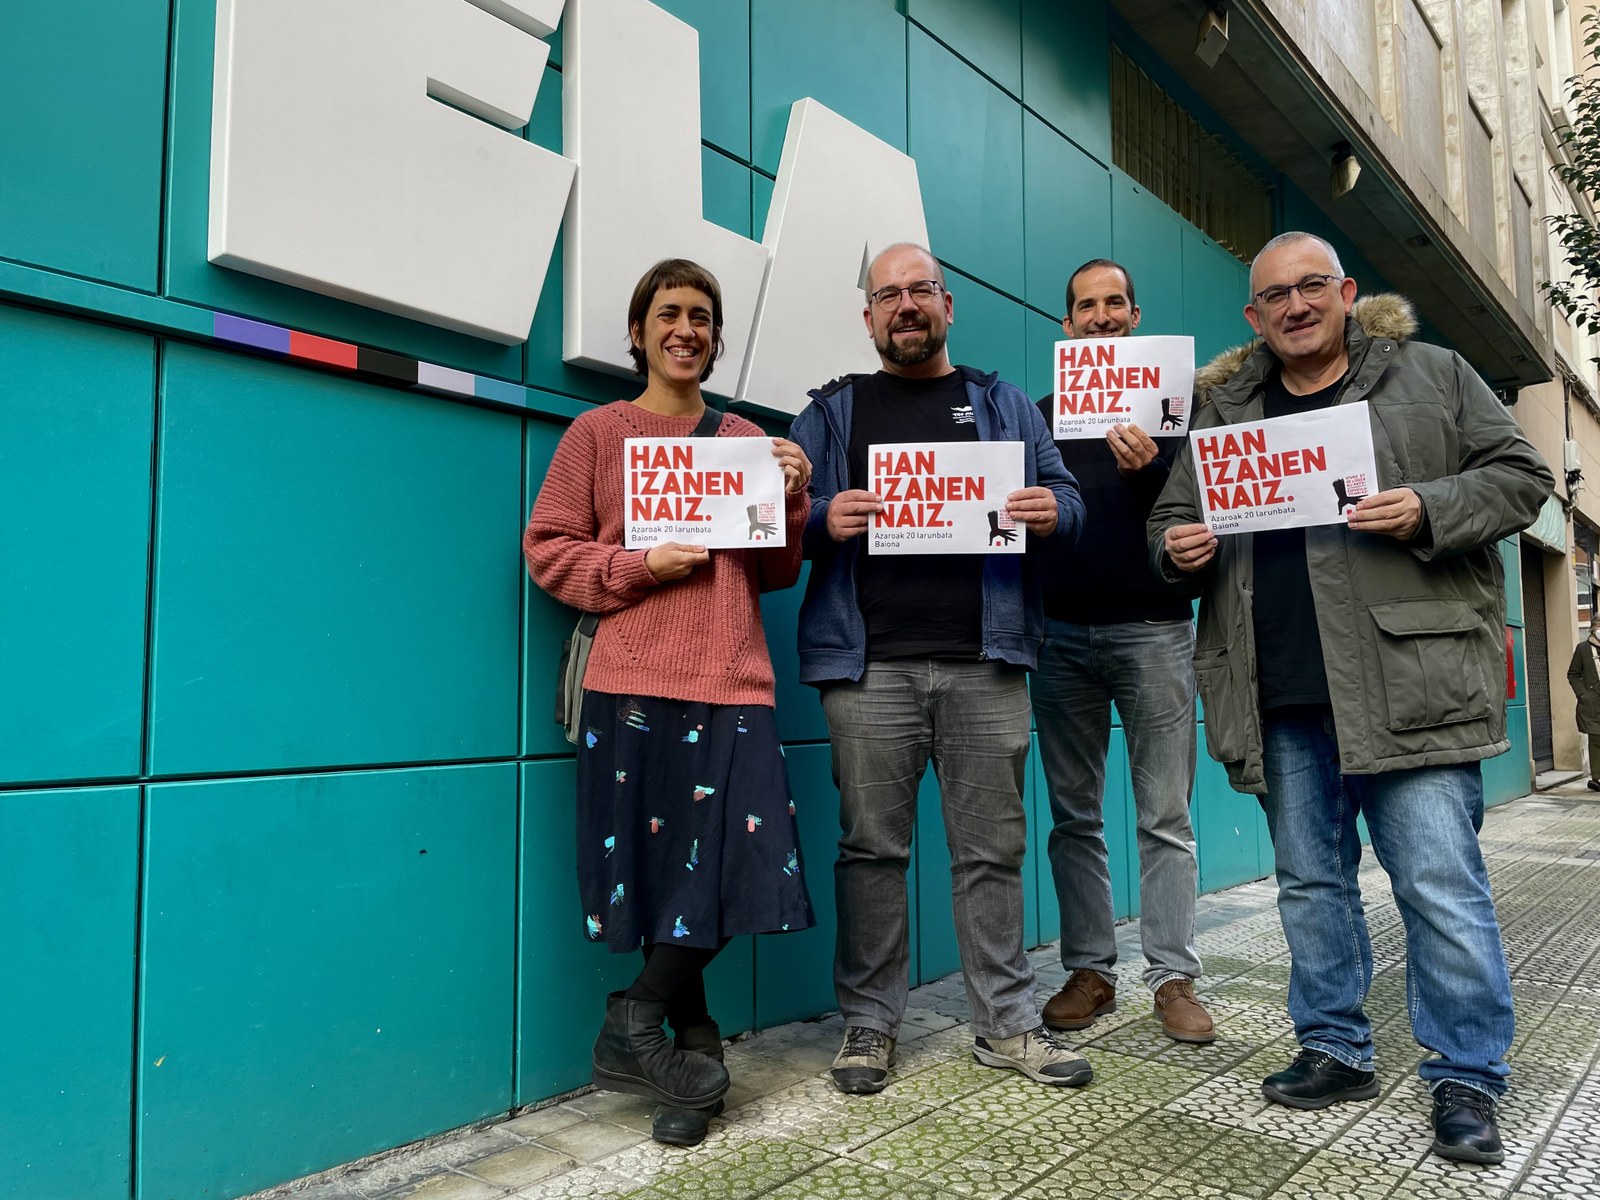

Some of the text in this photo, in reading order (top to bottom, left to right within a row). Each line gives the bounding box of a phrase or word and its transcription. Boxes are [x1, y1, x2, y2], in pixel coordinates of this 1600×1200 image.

[207, 0, 934, 416] ELA
[1059, 345, 1115, 369] HAN
[1059, 367, 1160, 392] IZANEN
[1059, 391, 1131, 415] NAIZ.
[1059, 418, 1086, 426] Azaroak
[1097, 416, 1131, 424] larunbata
[630, 445, 693, 470] HAN
[1197, 429, 1267, 462] HAN
[874, 451, 935, 476] HAN
[1202, 446, 1327, 486] IZANEN
[631, 471, 744, 496] IZANEN
[874, 476, 985, 502] IZANEN
[1207, 479, 1294, 511] NAIZ.
[631, 496, 712, 522] NAIZ.
[874, 502, 953, 528] NAIZ.
[1211, 506, 1296, 522] Azaroak 20 larunbata
[631, 525, 712, 533] Azaroak 20 larunbata
[631, 534, 658, 542] Baiona
[917, 531, 953, 539] larunbata
[1212, 522, 1239, 530] Baiona
[874, 540, 900, 548] Baiona
